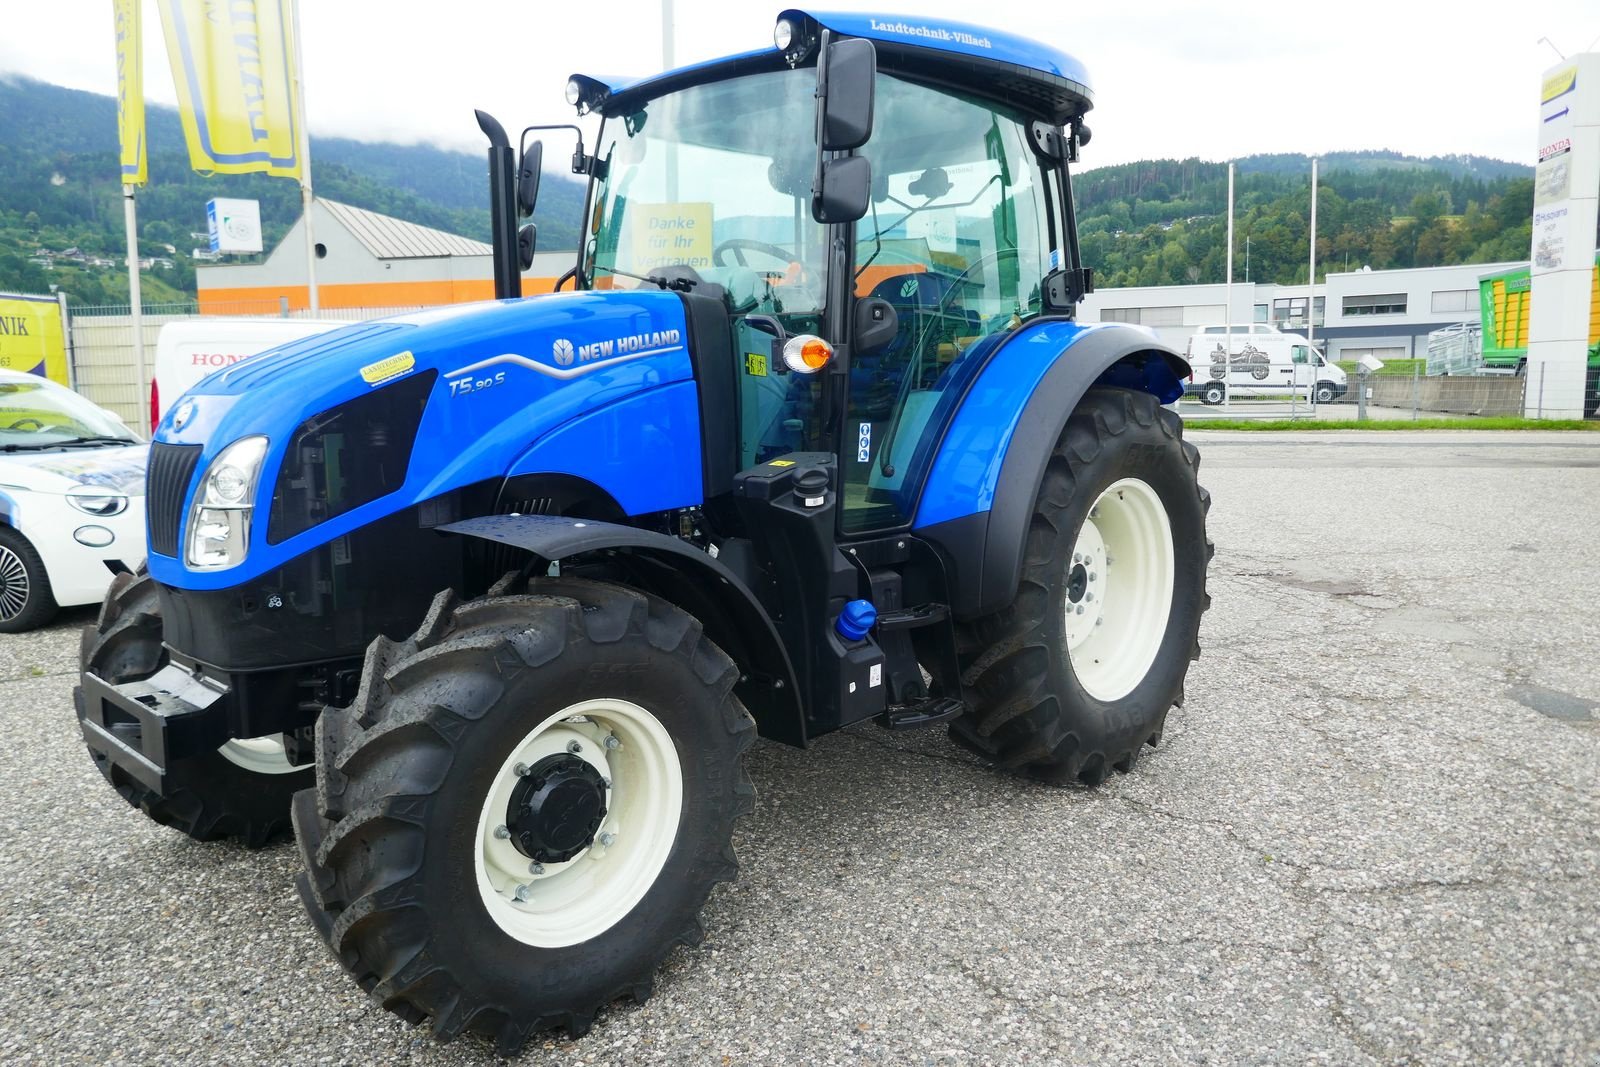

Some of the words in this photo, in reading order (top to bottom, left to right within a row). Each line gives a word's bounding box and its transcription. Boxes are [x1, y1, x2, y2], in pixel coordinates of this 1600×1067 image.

[870, 19, 992, 48] Landtechnik-Villach
[1539, 138, 1570, 158] HONDA
[648, 216, 695, 229] Danke
[648, 235, 668, 248] für
[674, 235, 694, 248] Ihr
[637, 255, 709, 268] Vertrauen
[579, 340, 614, 361] NEW
[617, 329, 680, 353] HOLLAND
[192, 353, 250, 366] HON
